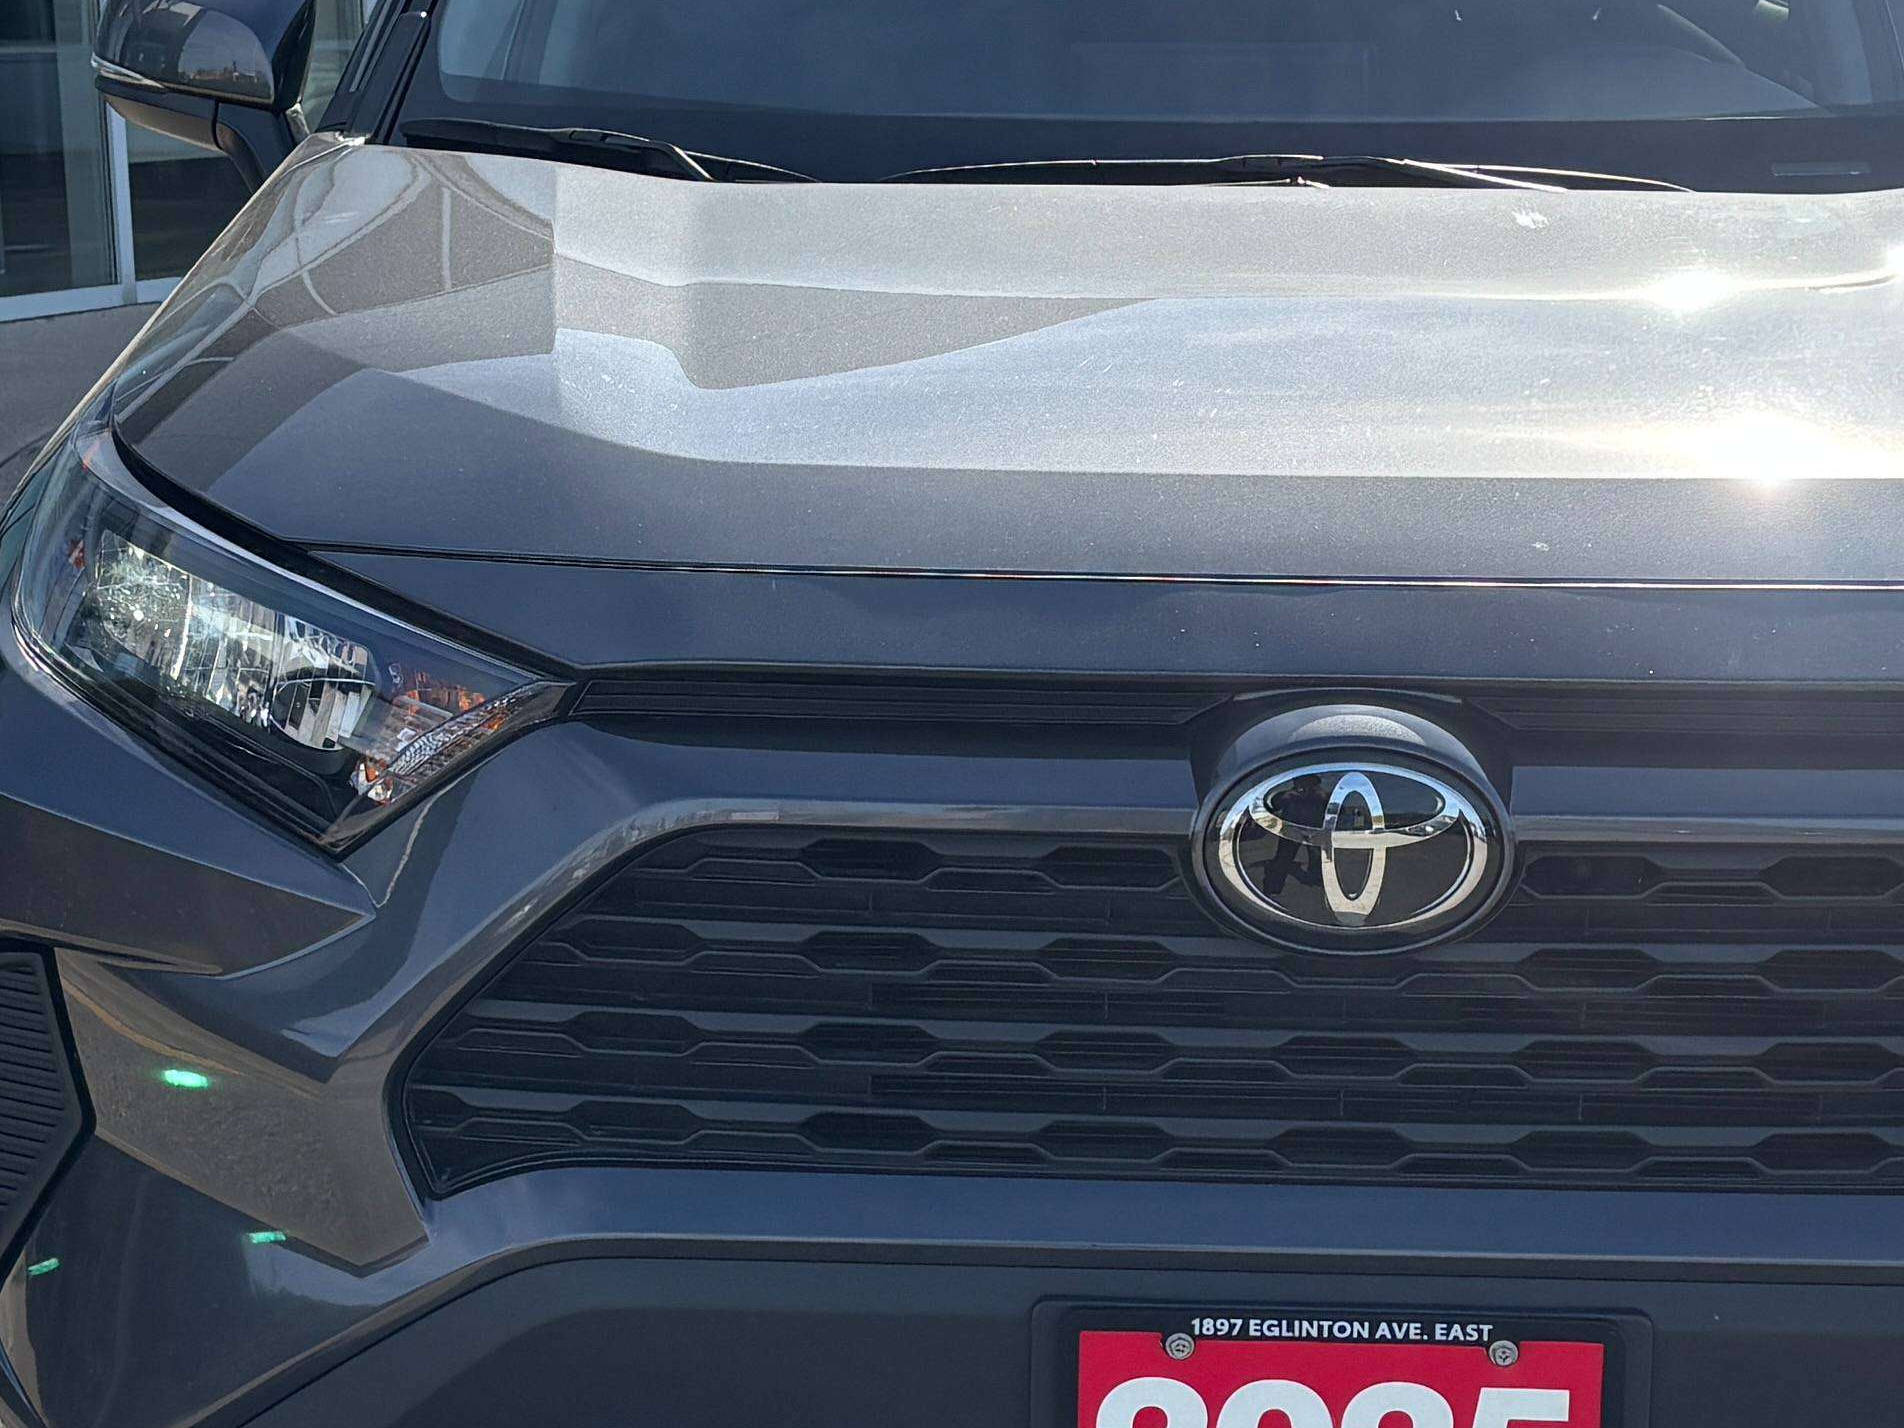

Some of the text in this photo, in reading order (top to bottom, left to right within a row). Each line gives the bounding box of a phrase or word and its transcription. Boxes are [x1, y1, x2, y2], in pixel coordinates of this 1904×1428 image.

[1191, 1318, 1494, 1342] 1897 EGLINTON AVE. EAST
